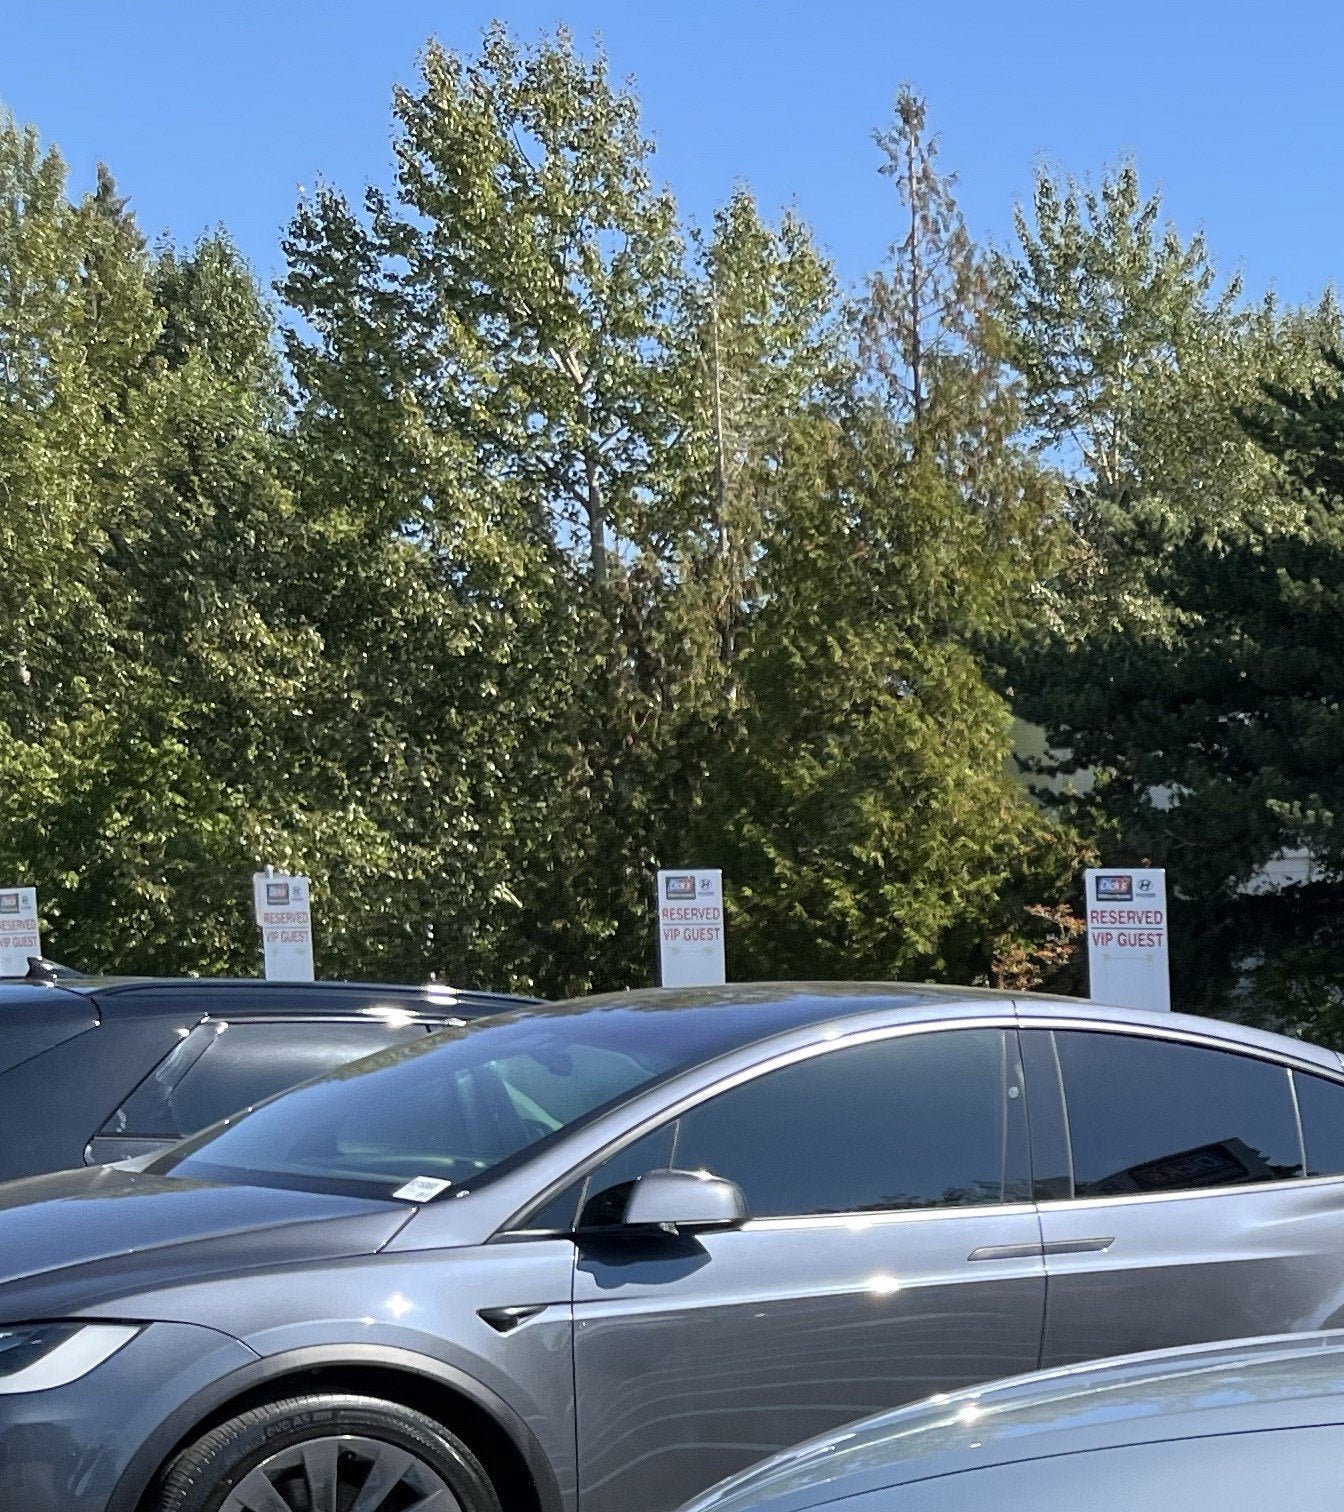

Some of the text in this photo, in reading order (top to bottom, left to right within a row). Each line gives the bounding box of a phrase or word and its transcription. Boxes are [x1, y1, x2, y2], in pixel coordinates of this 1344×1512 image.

[662, 907, 720, 920] RESERVED
[1090, 910, 1163, 924] RESERVED
[663, 928, 720, 941] VIP GUEST
[1092, 932, 1163, 947] VIP GUEST
